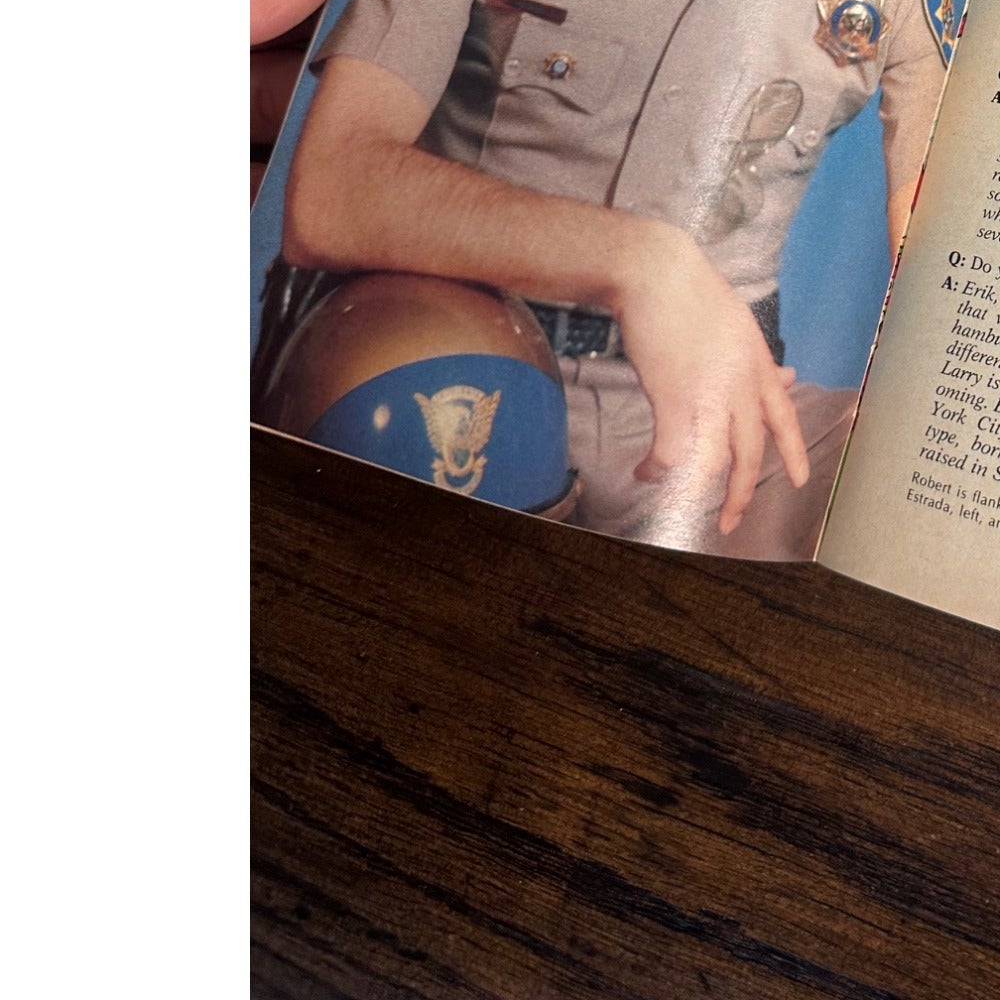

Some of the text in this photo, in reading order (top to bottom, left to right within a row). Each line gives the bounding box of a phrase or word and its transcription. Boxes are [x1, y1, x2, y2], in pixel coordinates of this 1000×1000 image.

[948, 250, 966, 268] Q:
[970, 255, 992, 273] Do
[935, 385, 988, 412] oming.
[911, 470, 952, 495] Robert
[956, 485, 967, 499] is
[906, 488, 954, 516] Estrada,
[958, 503, 983, 526] left,
